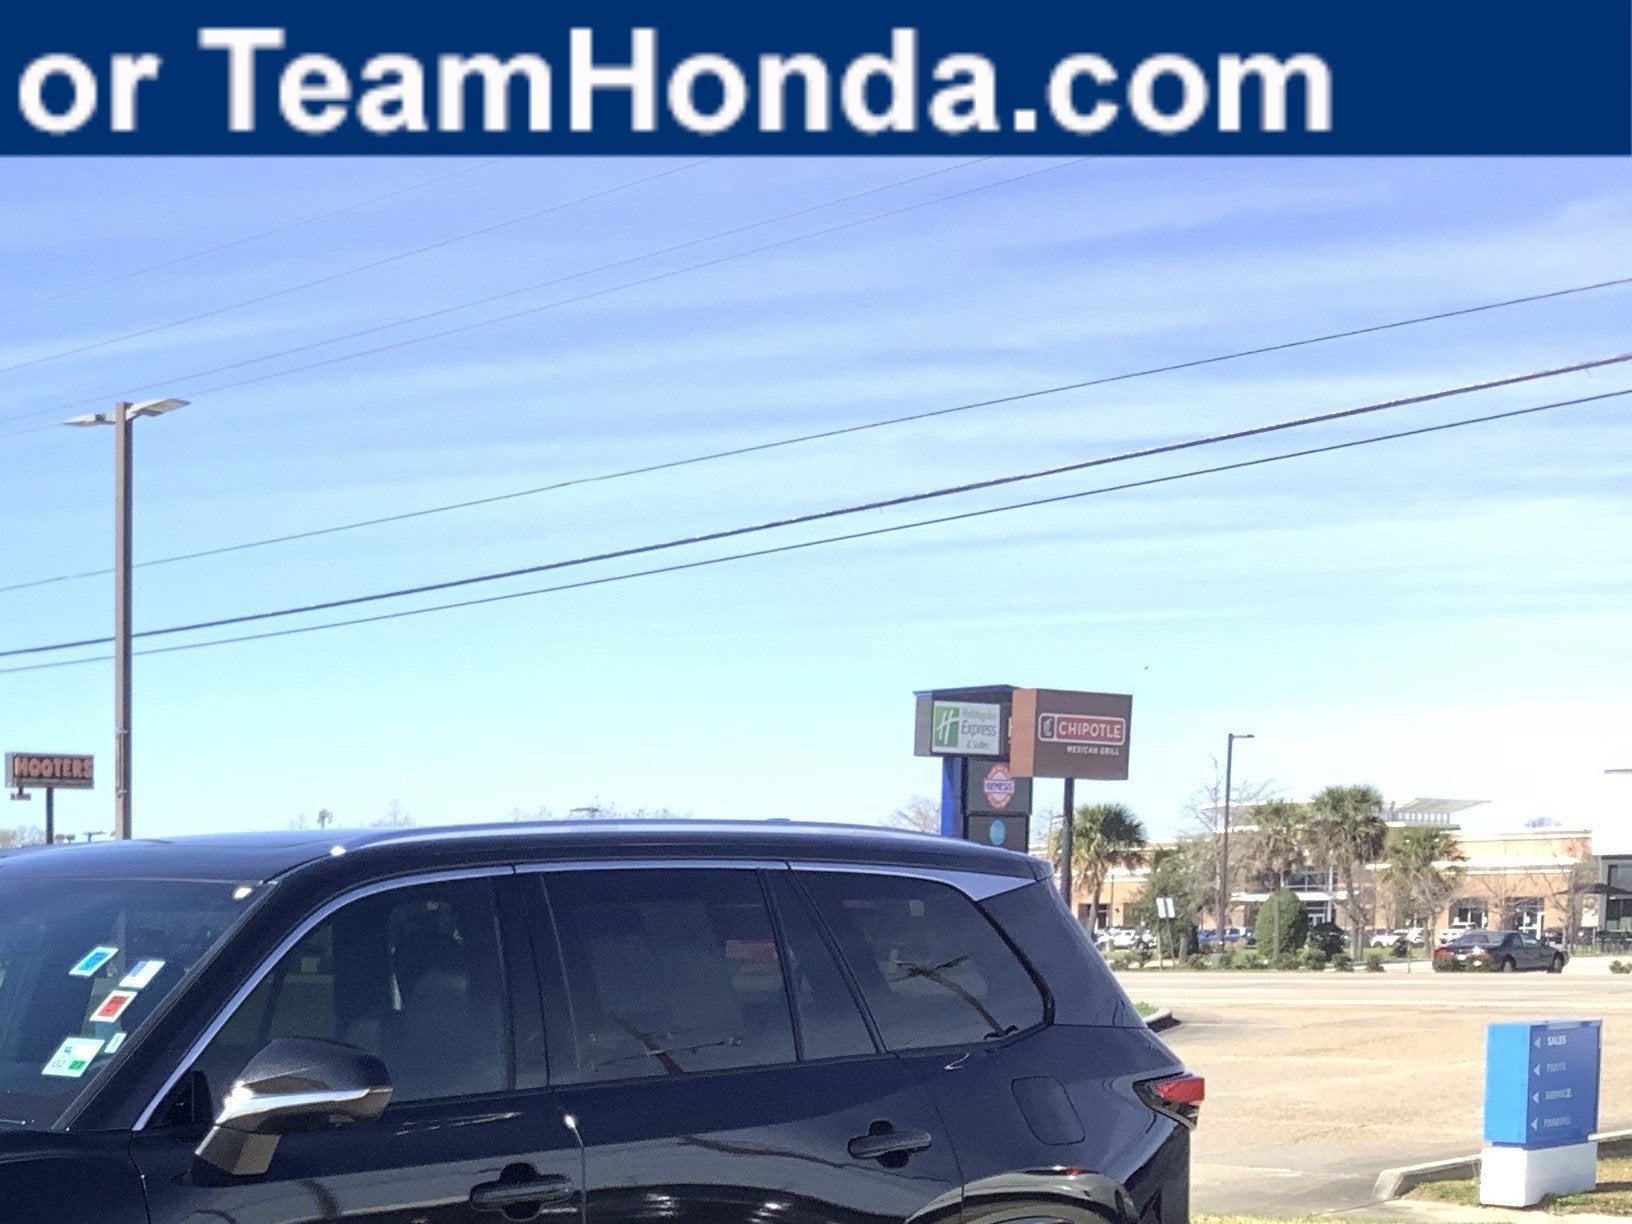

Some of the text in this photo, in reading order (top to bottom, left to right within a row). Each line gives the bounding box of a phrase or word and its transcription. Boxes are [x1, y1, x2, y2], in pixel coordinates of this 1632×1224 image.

[961, 719, 997, 738] Express
[1058, 721, 1121, 739] CHIPOTLE
[1067, 745, 1120, 756] MEXICAN GRILL
[14, 756, 91, 778] HOOTERS
[1547, 1035, 1567, 1046] SALES
